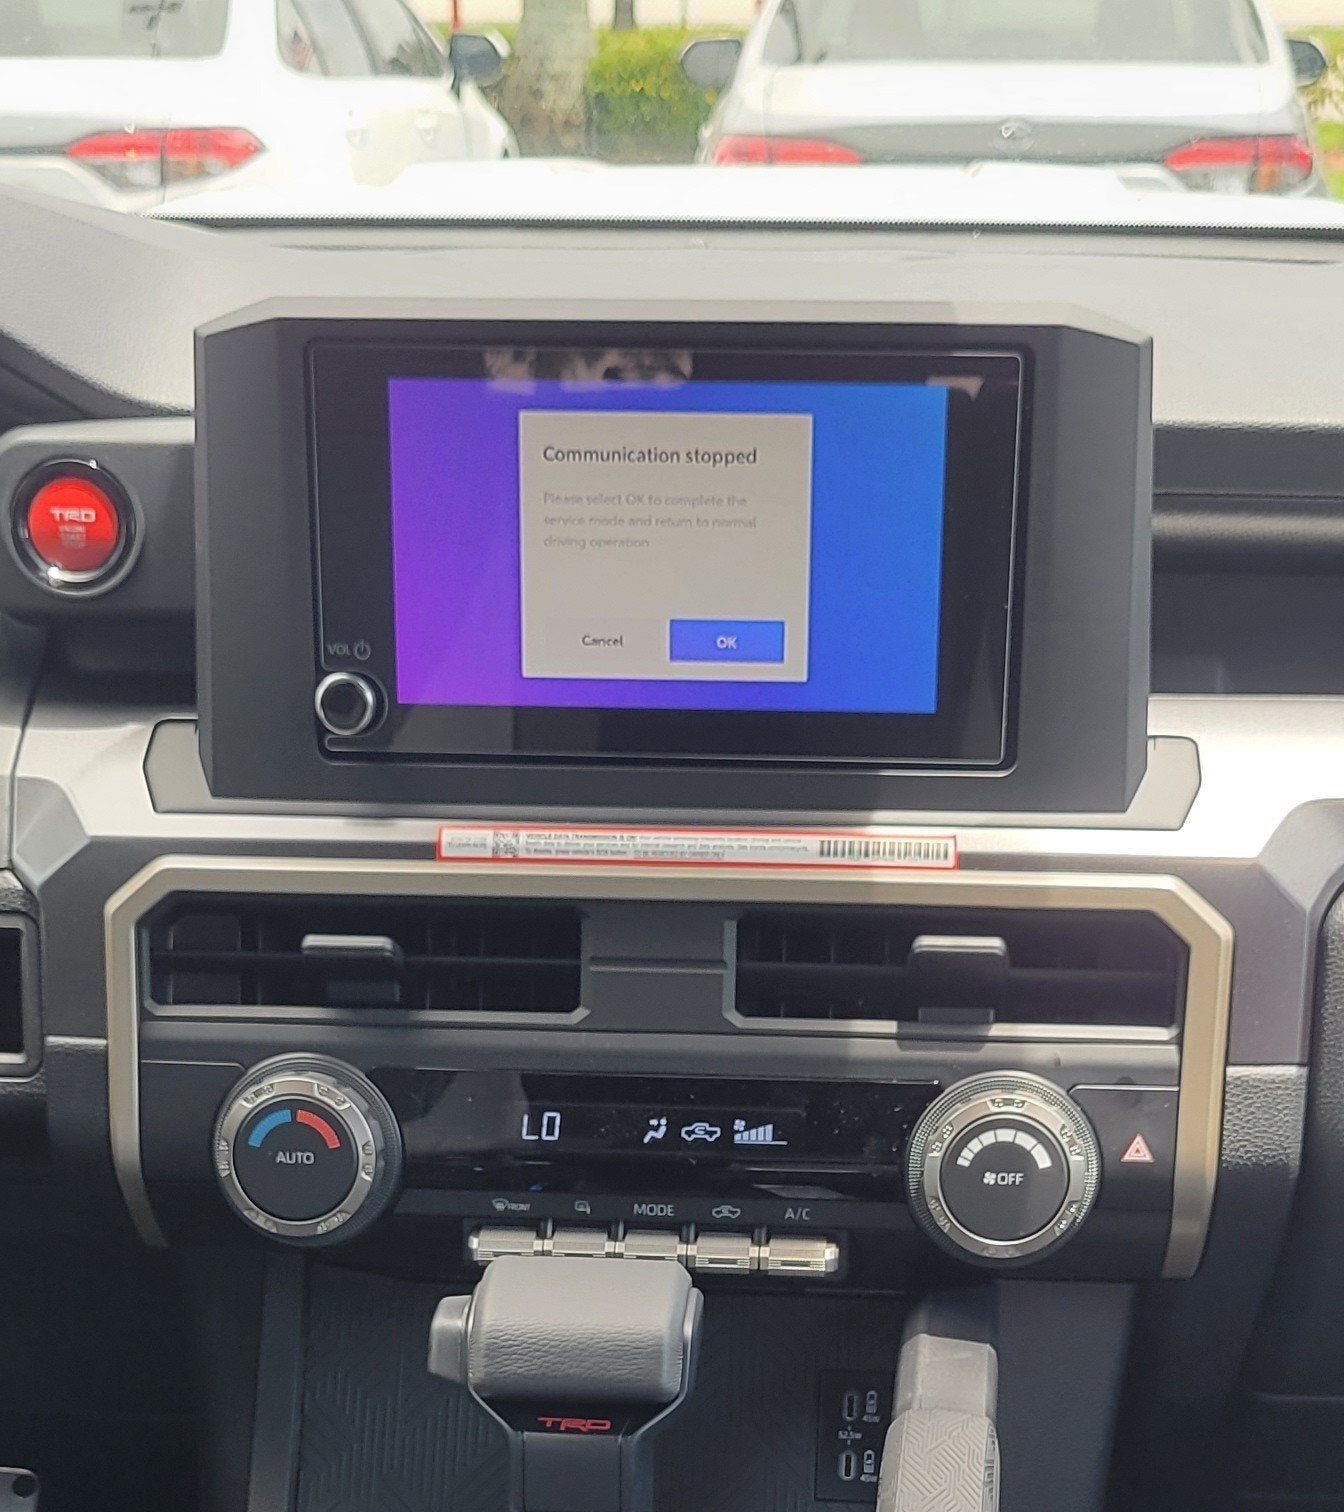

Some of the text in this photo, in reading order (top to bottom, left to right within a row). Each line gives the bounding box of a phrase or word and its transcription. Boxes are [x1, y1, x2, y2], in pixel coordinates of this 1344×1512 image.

[542, 445, 758, 468] Communication stopped
[543, 492, 584, 506] Please
[586, 493, 622, 506] select
[625, 493, 646, 506] OK
[648, 493, 662, 506] to
[50, 507, 96, 523] TRD
[581, 634, 624, 648] Cancel
[716, 635, 738, 650] OK
[327, 643, 351, 656] VOL
[275, 1150, 315, 1166] AUTO
[996, 1171, 1024, 1186] OFF
[633, 1203, 675, 1217] MODE
[784, 1207, 812, 1221] A/C
[537, 1415, 612, 1433] TRD
